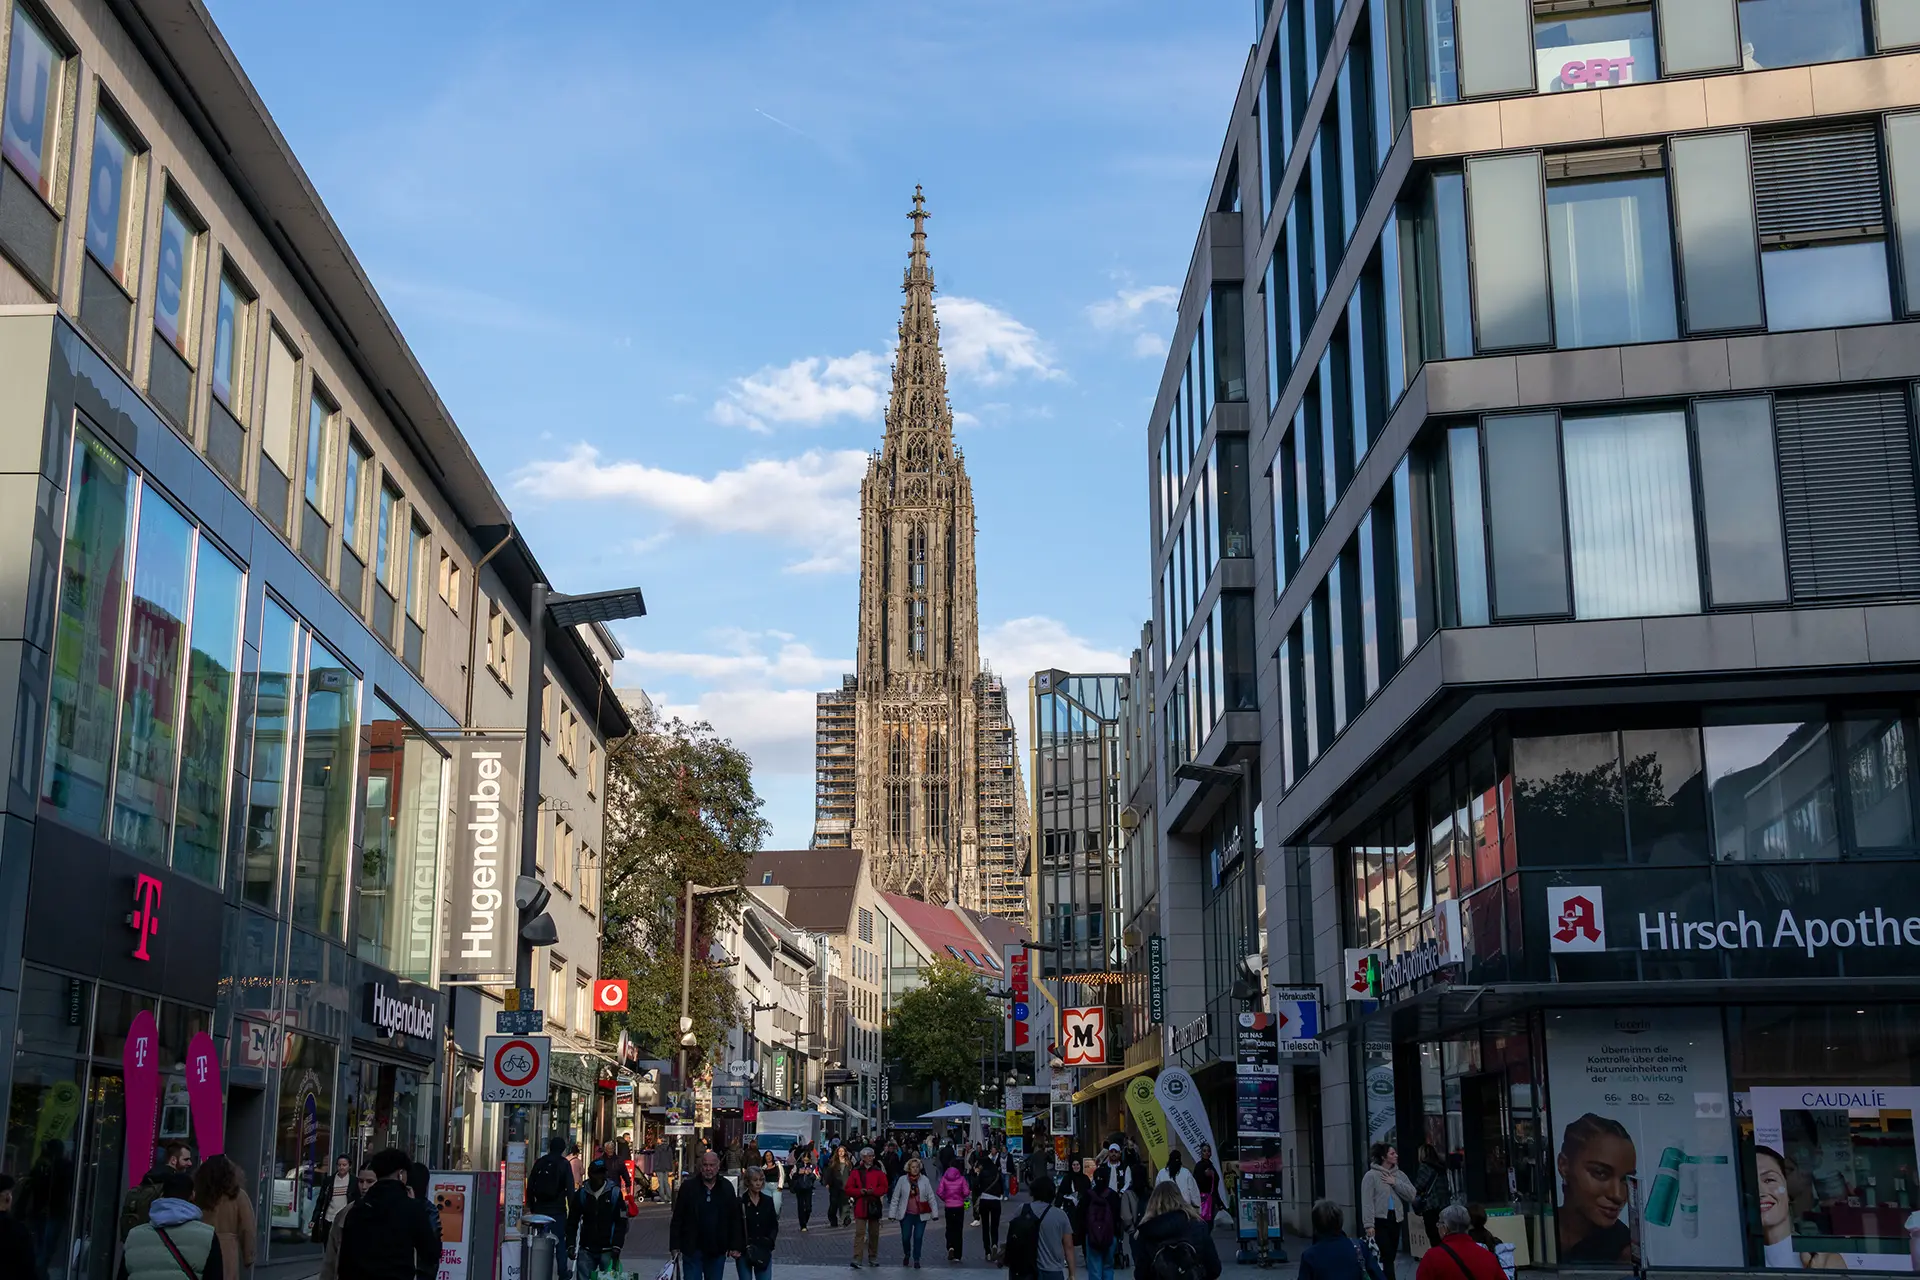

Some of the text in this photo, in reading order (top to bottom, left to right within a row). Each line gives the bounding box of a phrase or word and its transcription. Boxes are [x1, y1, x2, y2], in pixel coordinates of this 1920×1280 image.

[461, 751, 503, 958] Hugendubel
[132, 872, 163, 961] T
[1638, 908, 1762, 951] Hirsch
[1402, 944, 1439, 991] Apotheke
[1278, 990, 1317, 1002] Hörakustik
[373, 982, 435, 1040] Hugendubel
[1614, 1018, 1651, 1030] Eucerin
[1072, 1024, 1095, 1048] M
[136, 1036, 149, 1068] T
[1281, 1040, 1319, 1051] Tielesch
[1601, 1044, 1669, 1054] Übernimm die
[1587, 1054, 1684, 1064] Kontrolle über deine
[196, 1055, 209, 1083] T
[1586, 1064, 1688, 1073] Hautunreinheiten mit
[775, 1066, 784, 1097] Thalia
[1591, 1075, 1607, 1083] der
[1642, 1074, 1684, 1083] Wirkung
[434, 1184, 467, 1192] PRO
[445, 1257, 462, 1265] UNS
